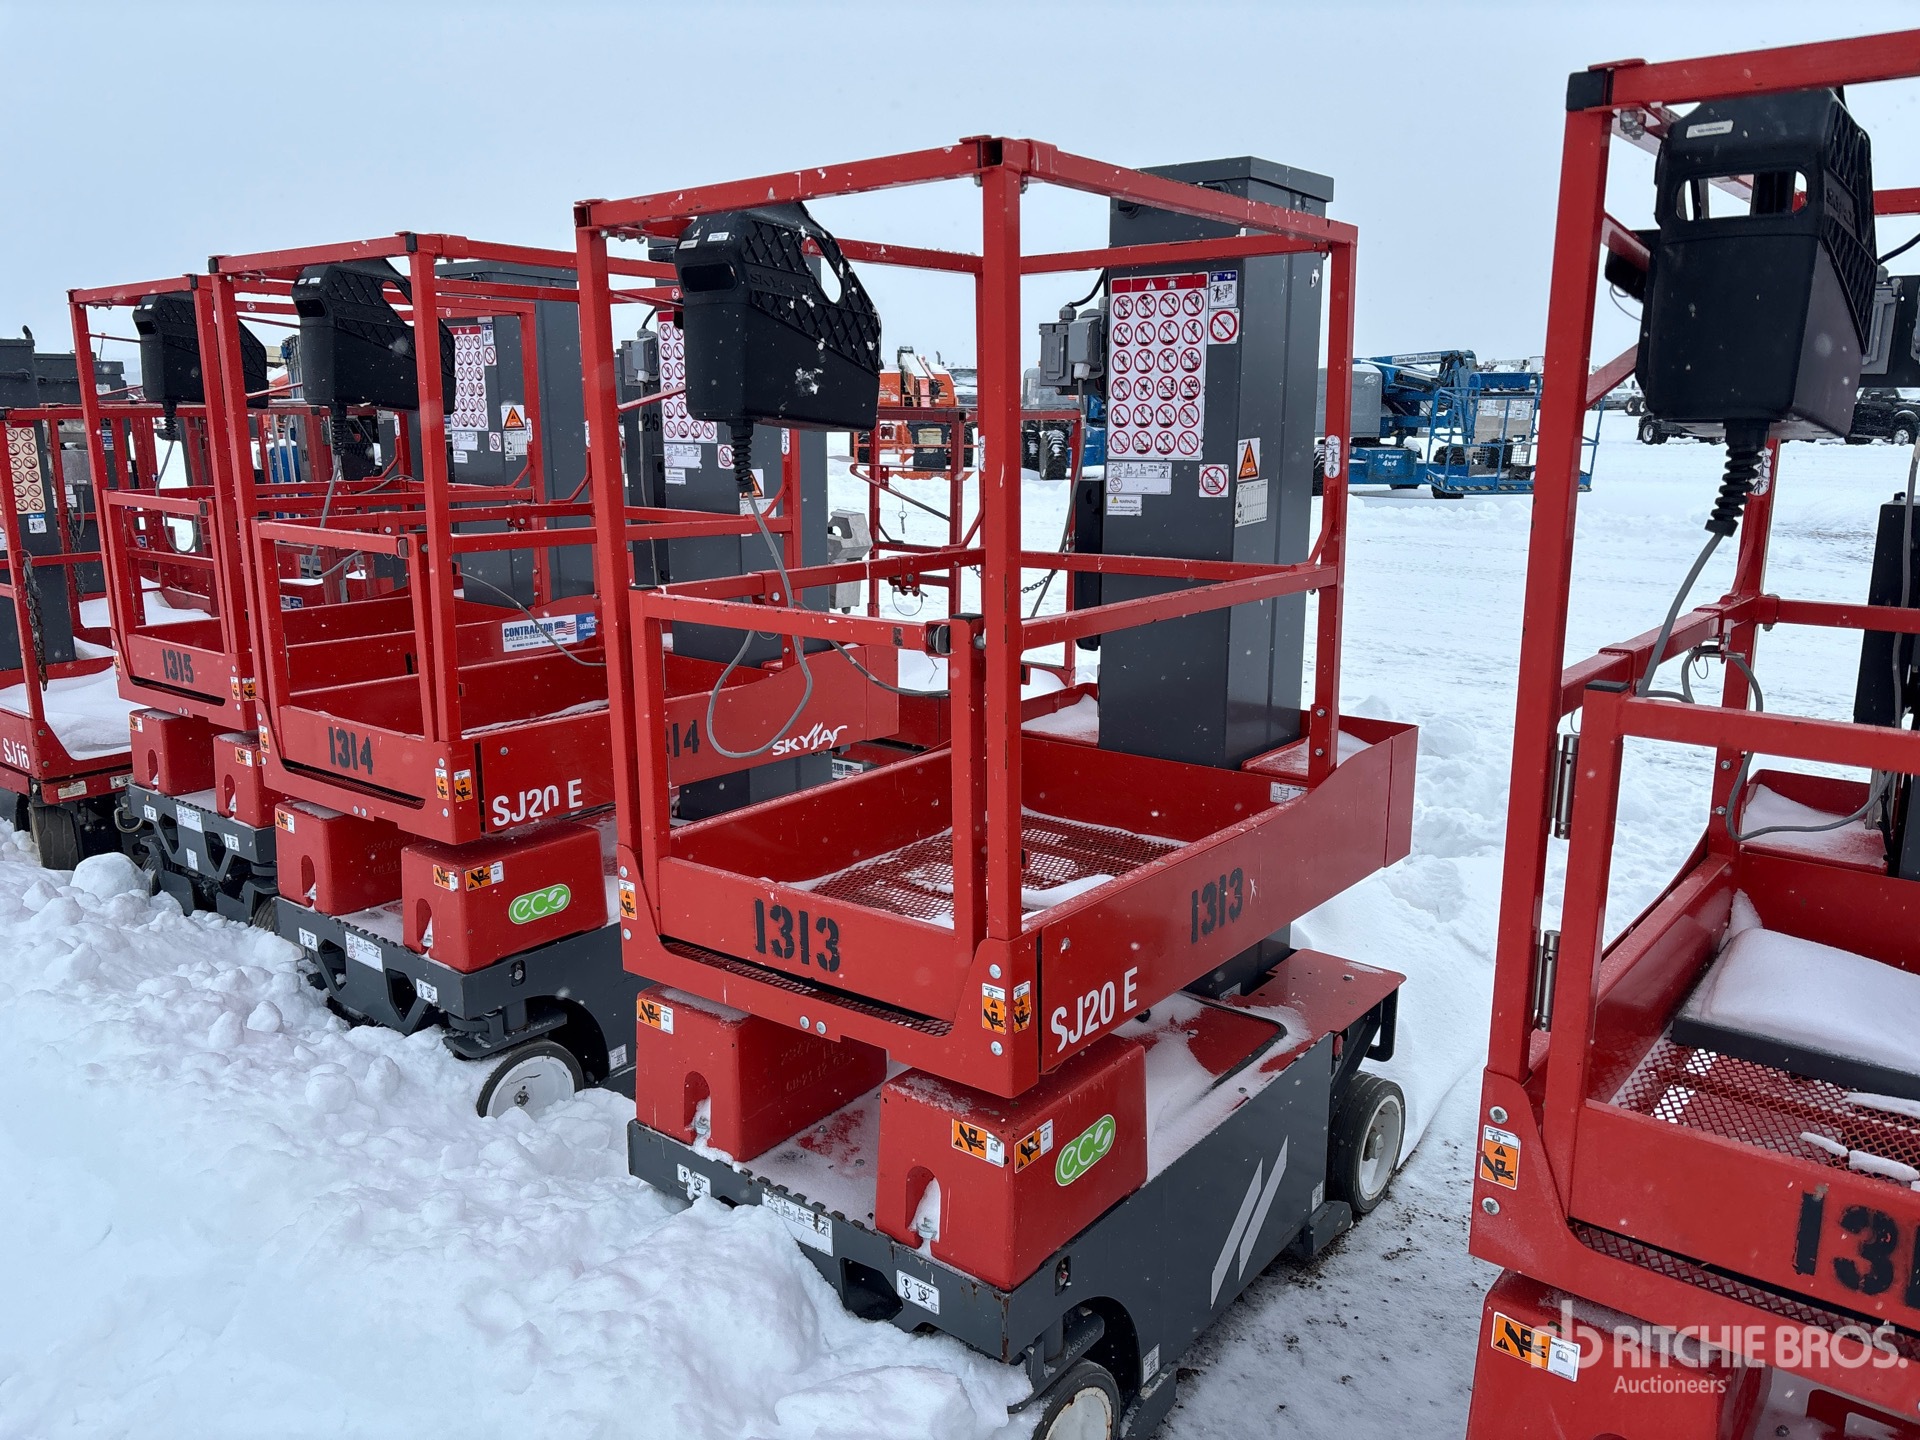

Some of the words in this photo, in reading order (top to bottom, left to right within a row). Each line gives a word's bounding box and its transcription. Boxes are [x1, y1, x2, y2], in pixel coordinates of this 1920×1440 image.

[162, 648, 194, 684] 1315
[3, 738, 30, 769] SJ16
[328, 726, 373, 776] 1314
[492, 784, 560, 827] SJ20
[567, 778, 583, 809] E
[513, 887, 567, 921] eco
[1191, 867, 1244, 945] 1313
[754, 898, 841, 973] 1313
[1050, 981, 1116, 1054] SJ20
[1123, 966, 1138, 1013] E
[1059, 1120, 1112, 1180] eco
